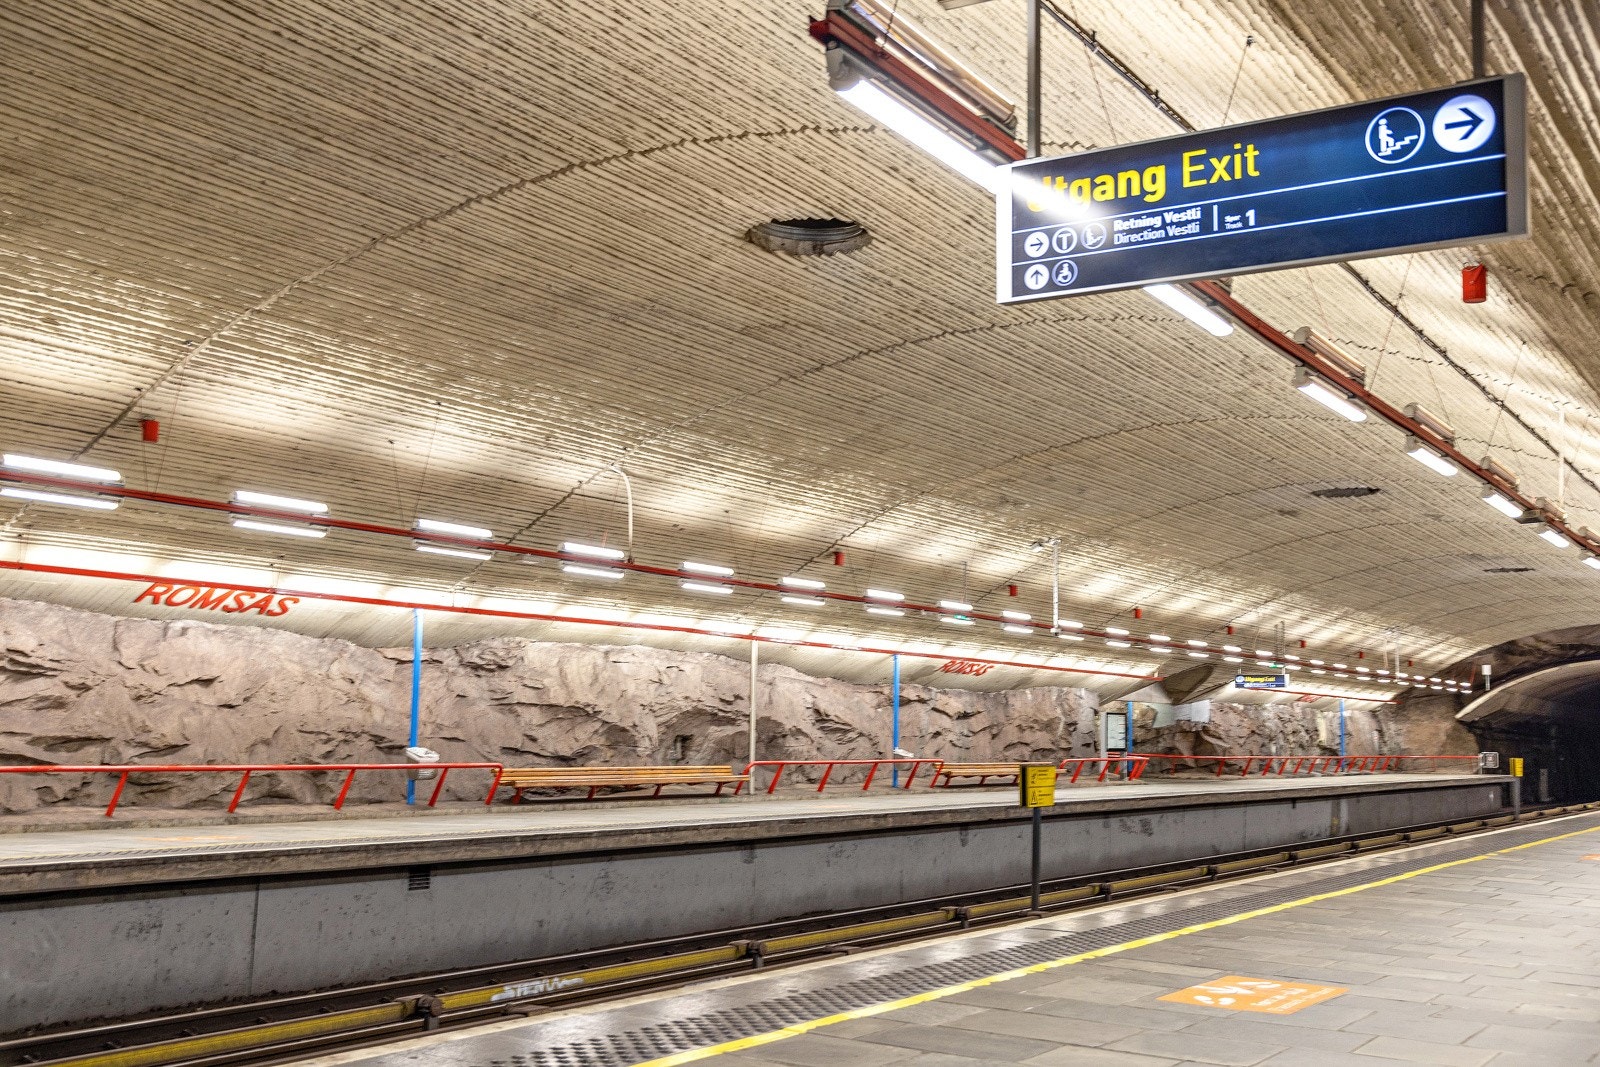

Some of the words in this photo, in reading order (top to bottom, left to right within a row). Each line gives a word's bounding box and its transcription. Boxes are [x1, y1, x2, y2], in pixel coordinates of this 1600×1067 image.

[1183, 143, 1260, 188] Exit
[1113, 215, 1162, 231] Retning
[1163, 207, 1202, 223] Vestli
[1245, 209, 1256, 227] 1
[1113, 229, 1165, 245] Direction
[1166, 221, 1200, 237] Vestli
